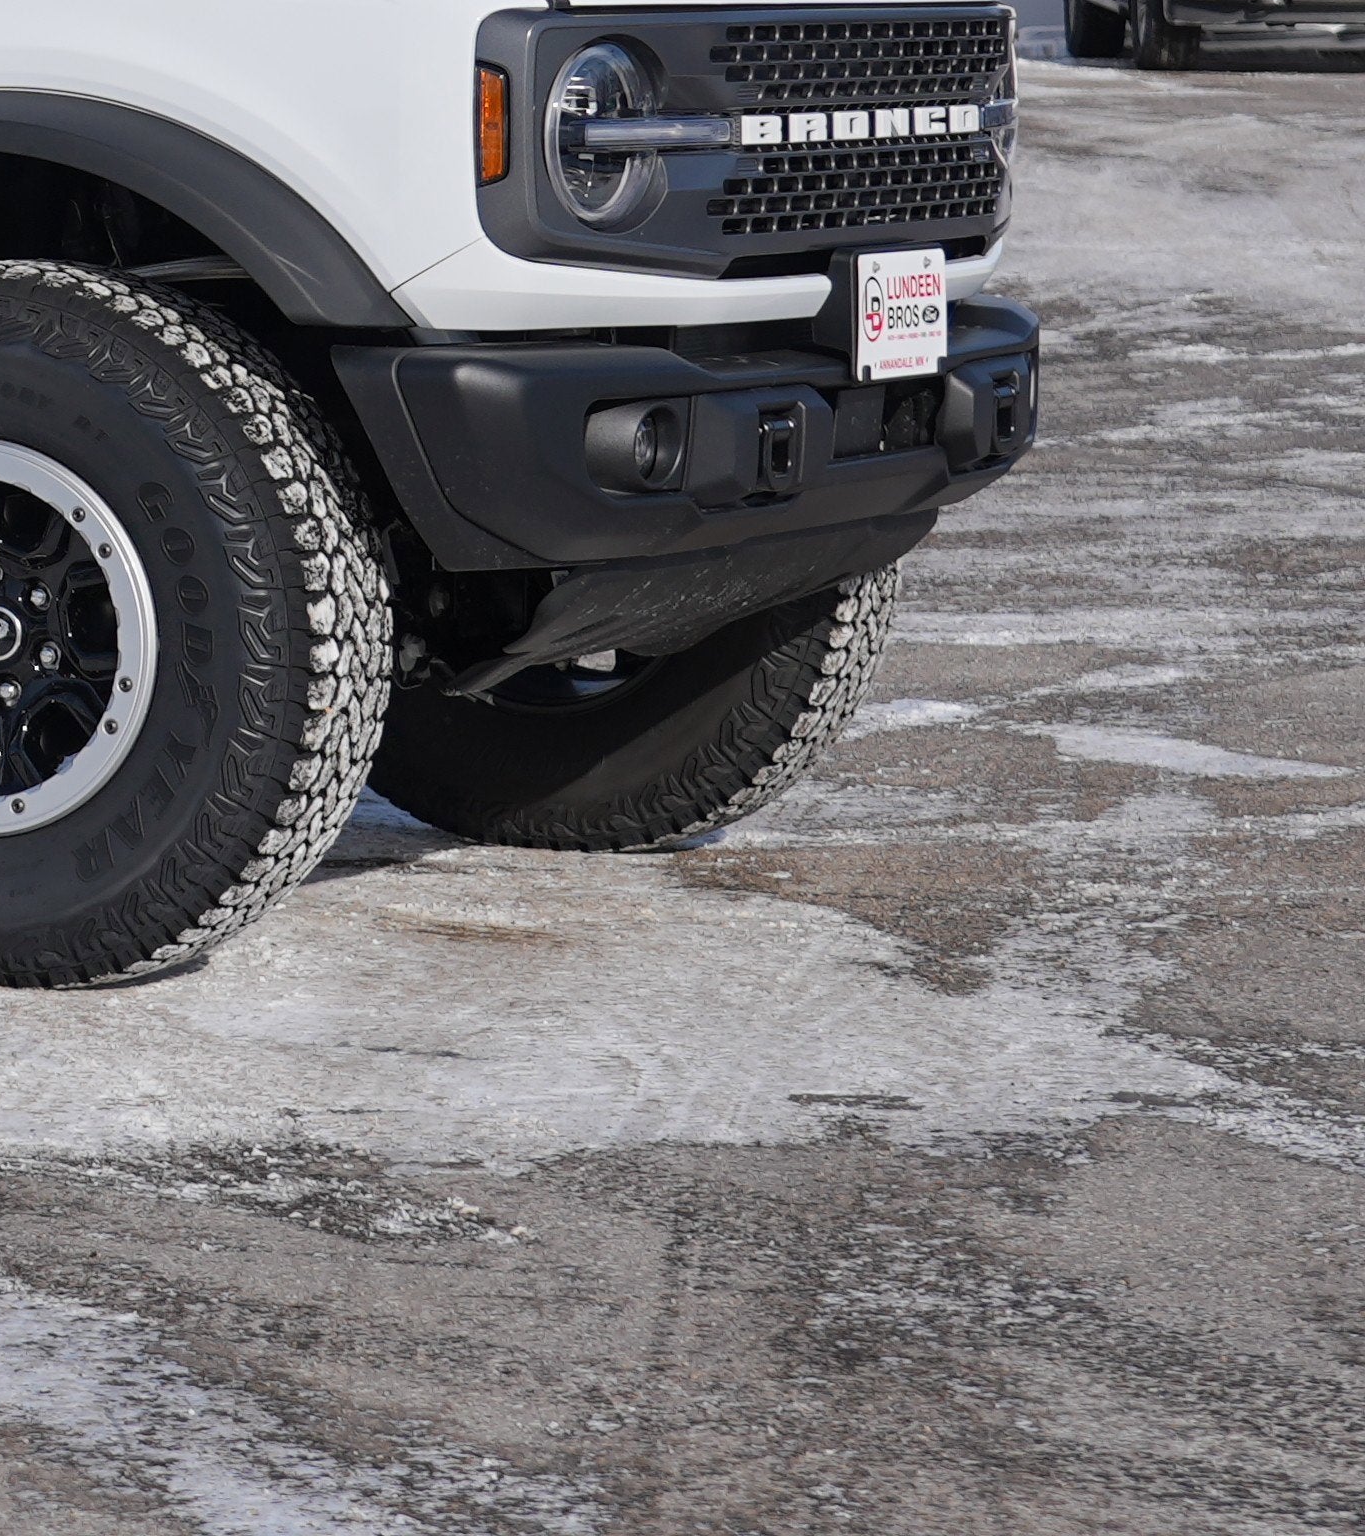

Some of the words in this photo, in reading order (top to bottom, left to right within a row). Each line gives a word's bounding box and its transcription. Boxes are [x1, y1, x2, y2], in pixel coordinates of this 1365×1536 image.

[740, 104, 980, 146] BRONCO
[886, 273, 941, 300] LUNDEEN
[887, 304, 920, 330] BROS
